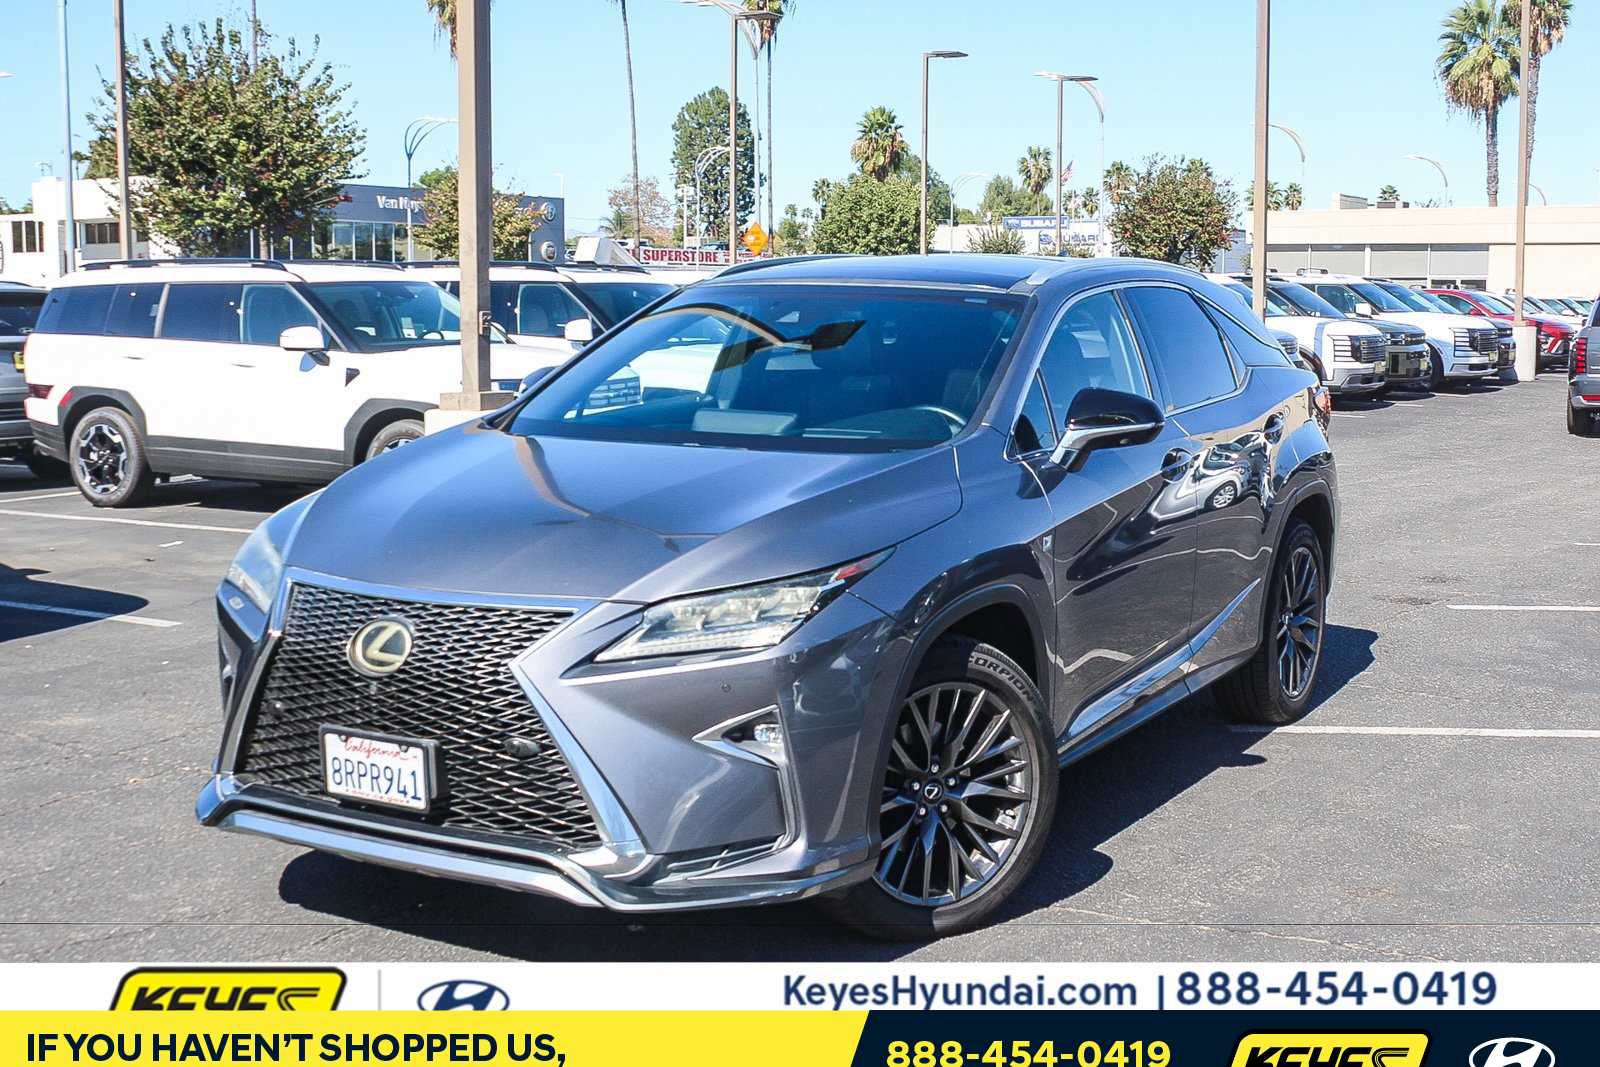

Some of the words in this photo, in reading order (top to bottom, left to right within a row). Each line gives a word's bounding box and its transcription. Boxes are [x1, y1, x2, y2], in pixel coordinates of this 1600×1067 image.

[376, 195, 398, 209] Van
[643, 249, 719, 263] SUPERSTORE
[331, 756, 422, 802] 8RPR941
